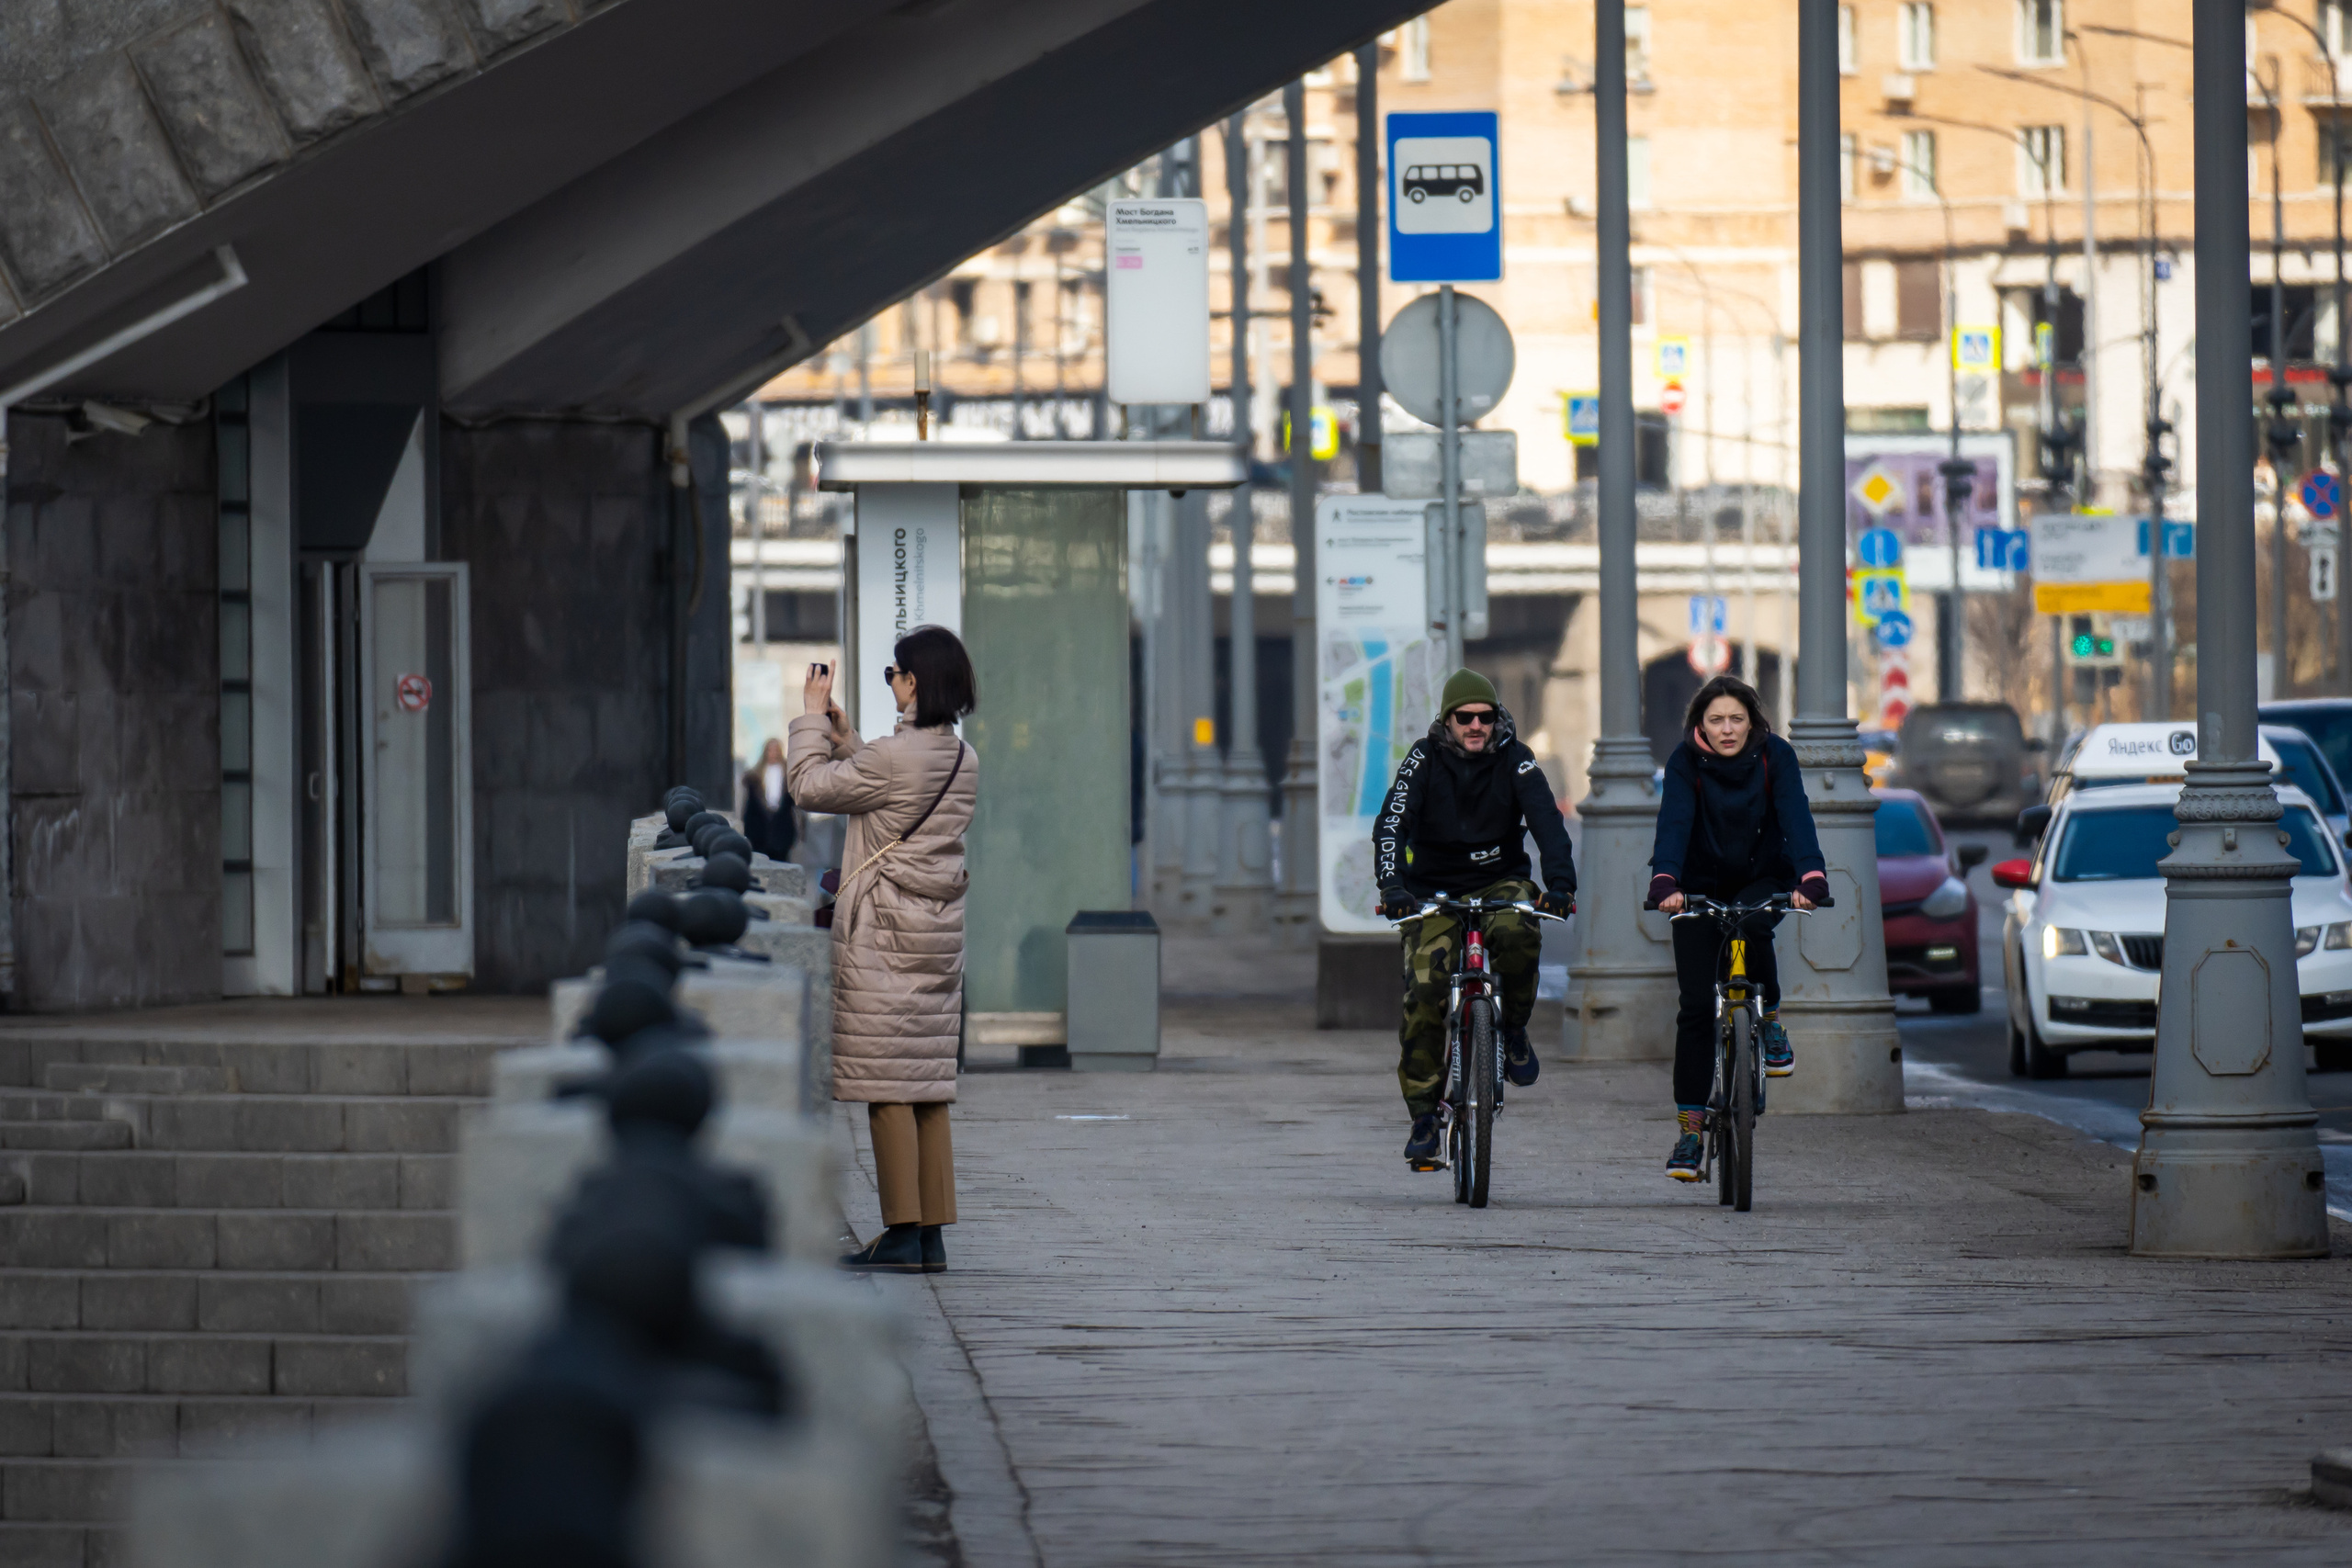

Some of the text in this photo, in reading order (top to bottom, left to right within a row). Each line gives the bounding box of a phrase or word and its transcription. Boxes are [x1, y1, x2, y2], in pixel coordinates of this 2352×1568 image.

[1114, 208, 1174, 217] Мост Богдана
[1114, 217, 1177, 226] Хмельницкого
[894, 527, 909, 641] ельницкого
[913, 527, 927, 621] Khmelnitskogo
[2108, 734, 2193, 755] Яндекс Go
